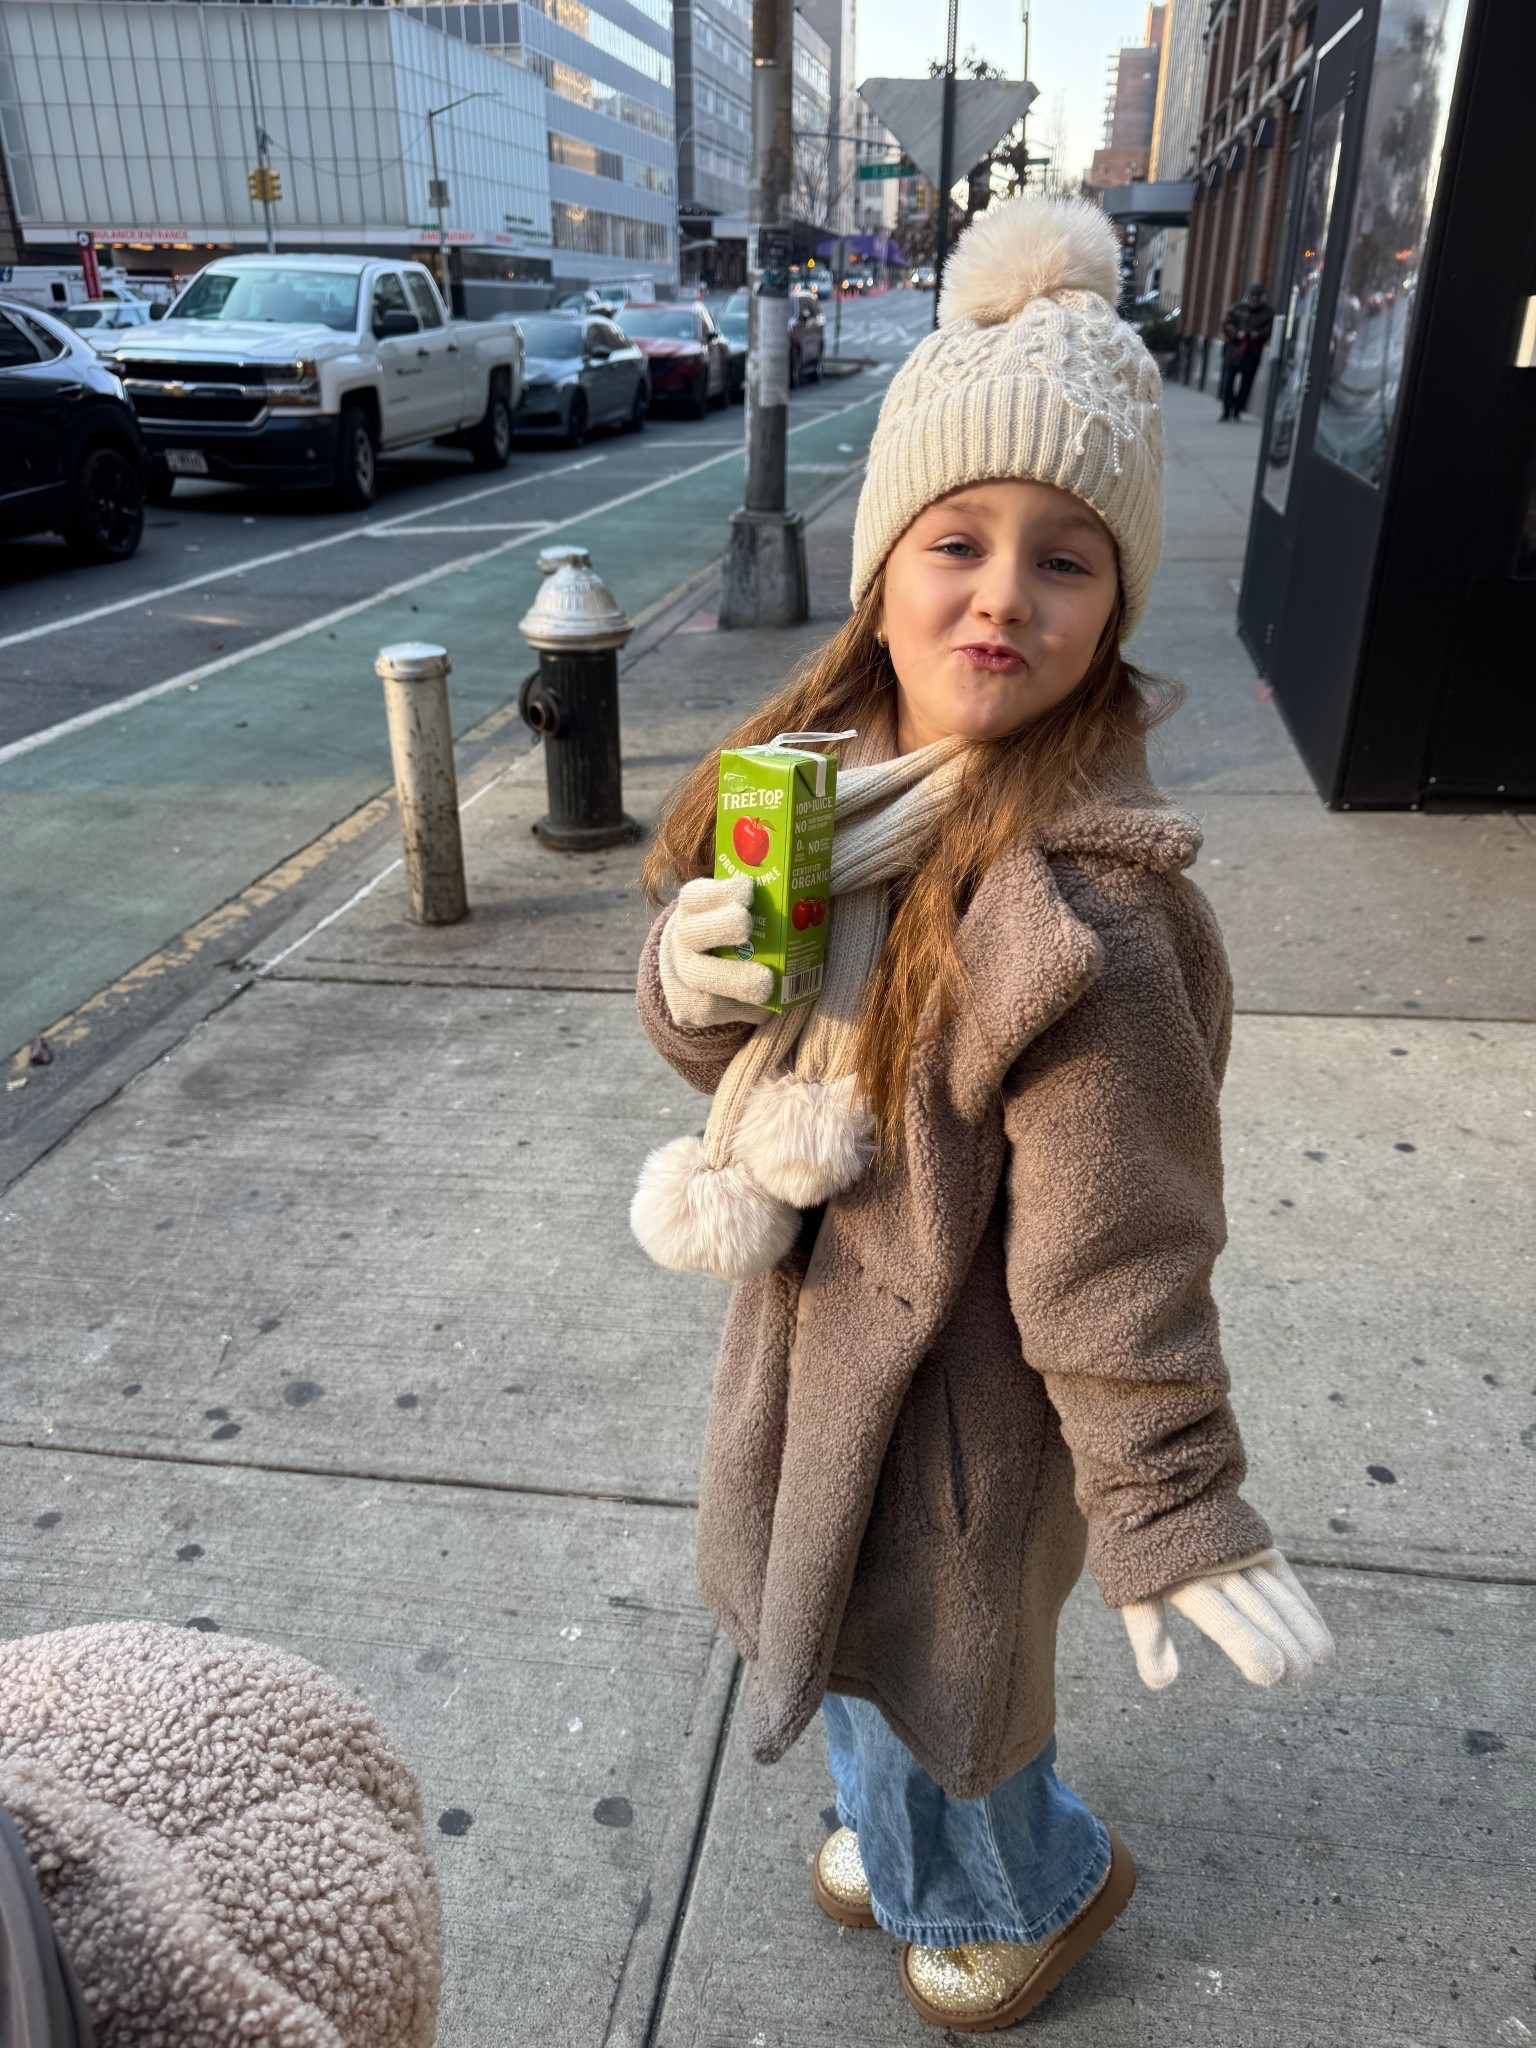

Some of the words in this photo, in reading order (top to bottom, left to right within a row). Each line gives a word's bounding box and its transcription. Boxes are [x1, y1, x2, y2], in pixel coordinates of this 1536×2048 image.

[91, 229, 135, 240] BULANCE
[138, 228, 189, 240] ENTRANCE
[420, 231, 476, 241] EMEGENCY
[812, 797, 833, 812] JUICE
[795, 820, 807, 834] NO
[808, 840, 820, 854] NO
[718, 853, 754, 880] ORGA
[756, 866, 781, 887] APPLE
[792, 863, 821, 877] CERTIFIED
[791, 869, 830, 890] ORGANIC
